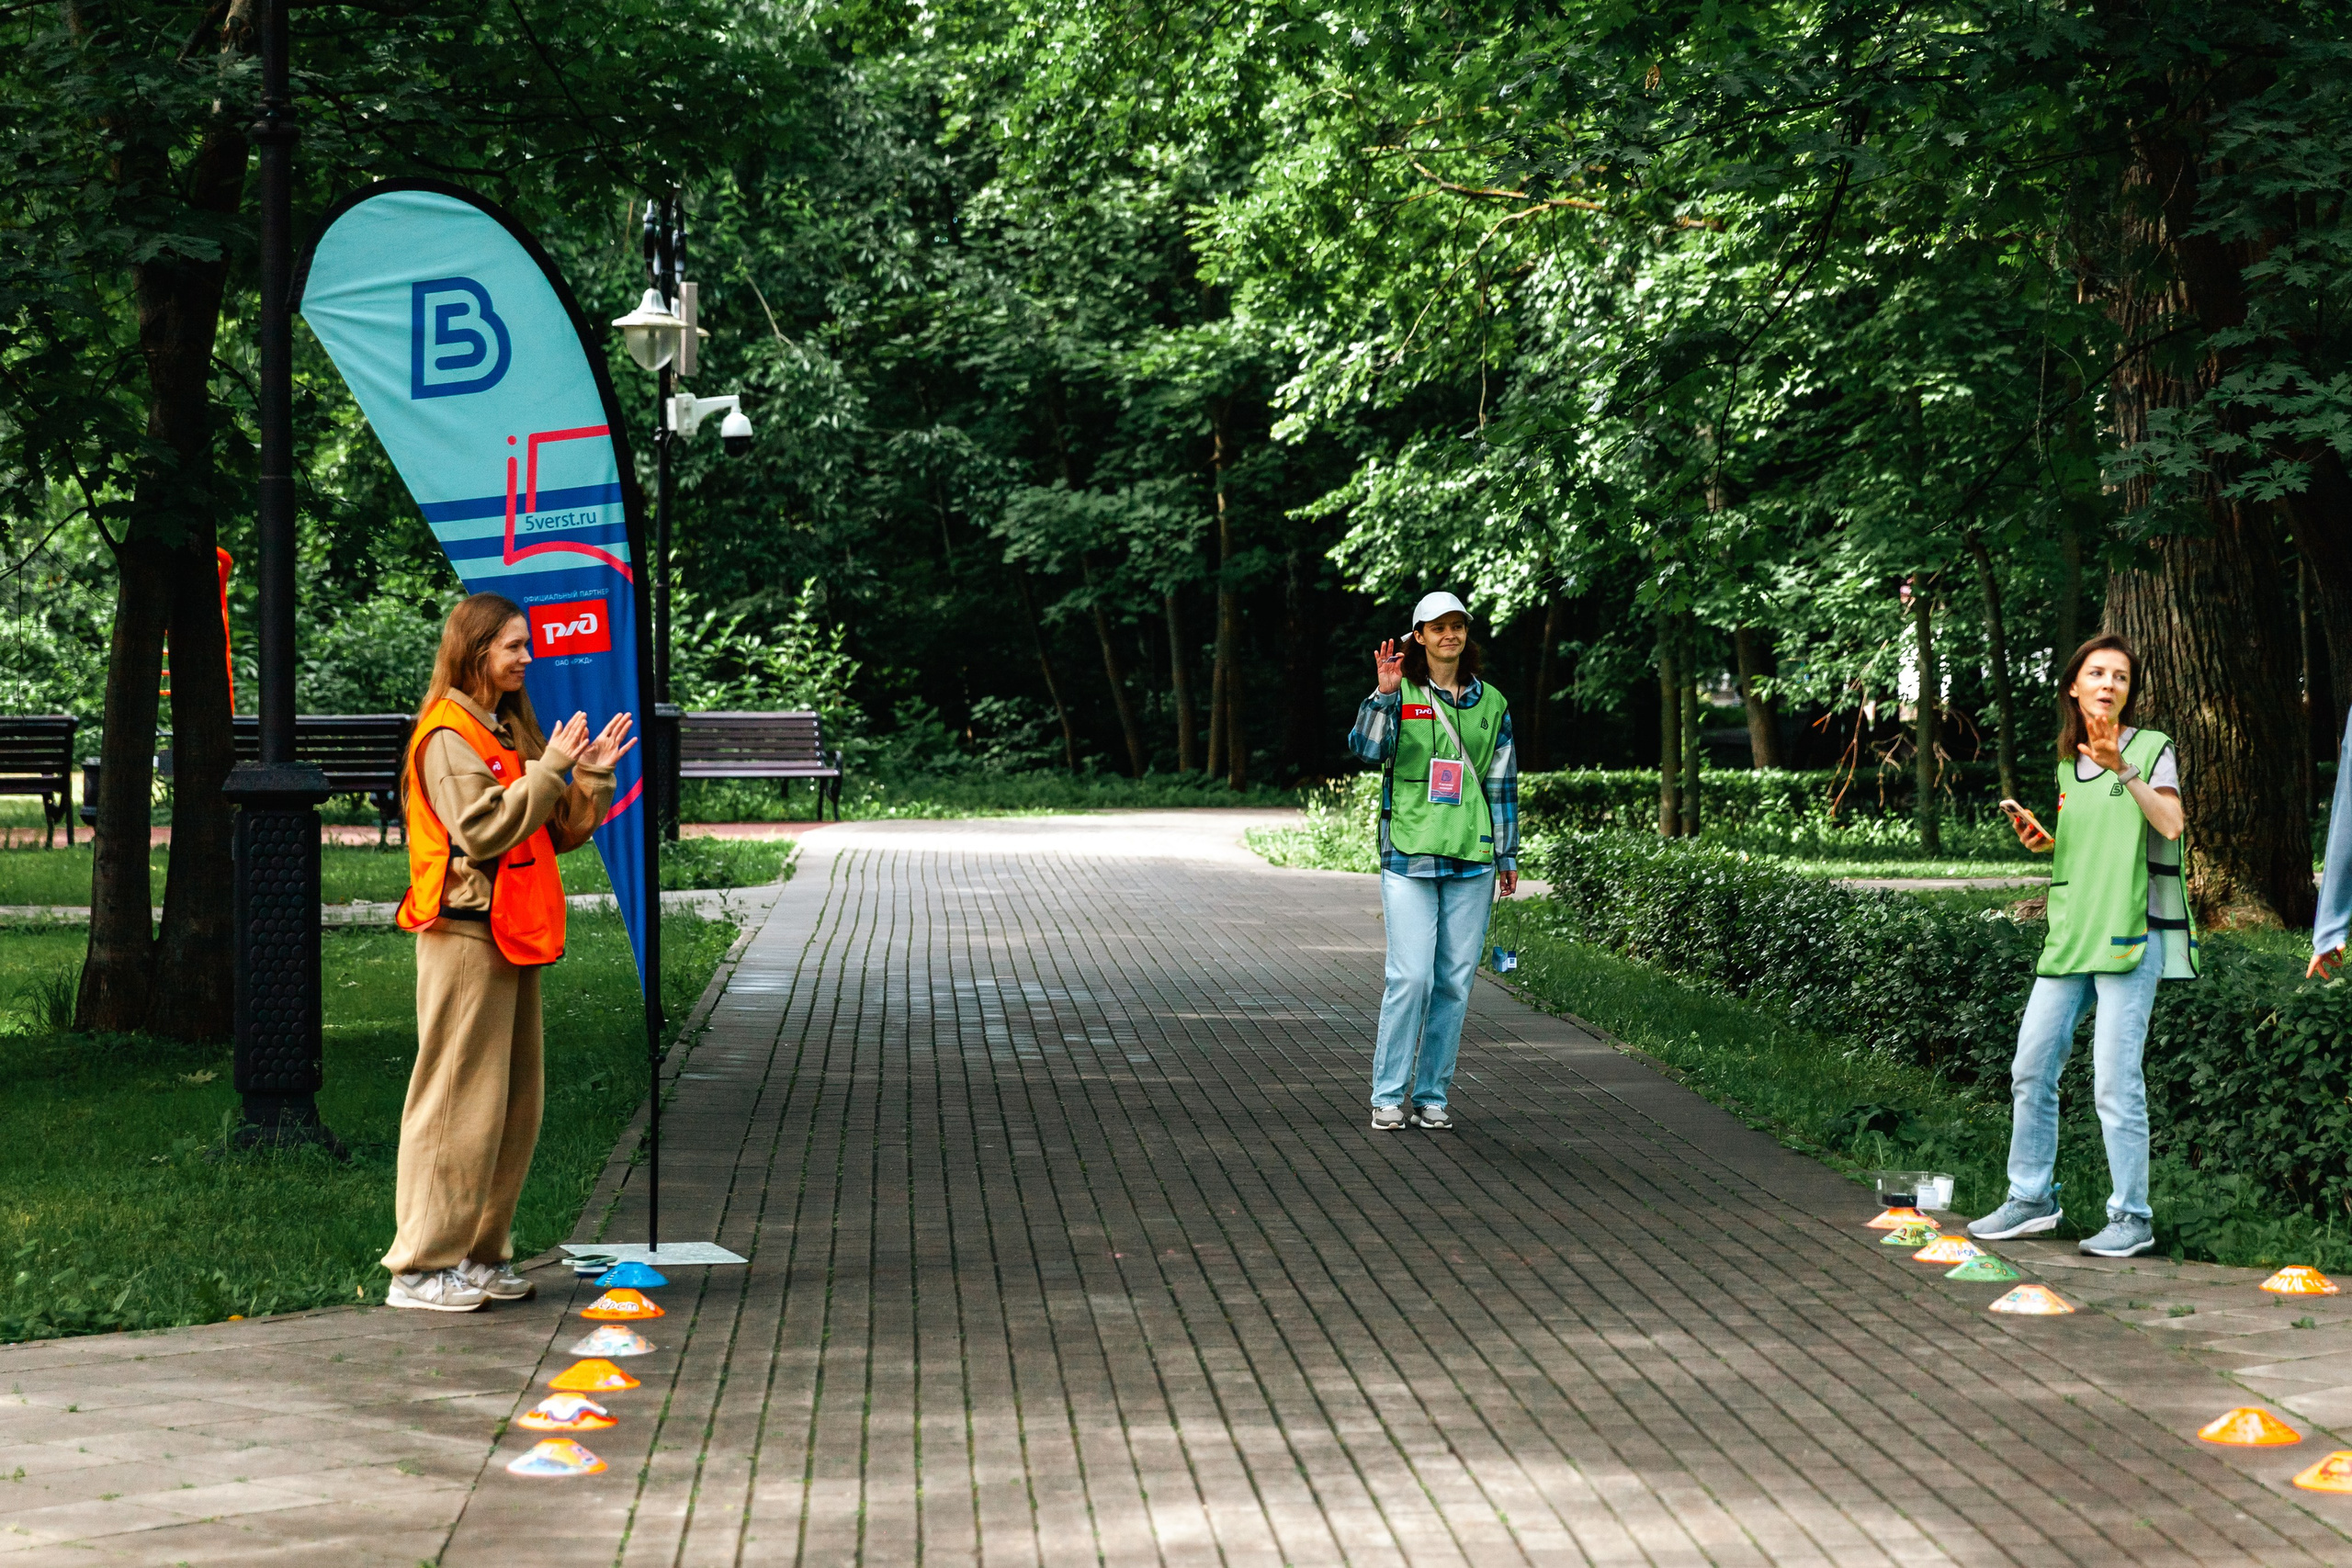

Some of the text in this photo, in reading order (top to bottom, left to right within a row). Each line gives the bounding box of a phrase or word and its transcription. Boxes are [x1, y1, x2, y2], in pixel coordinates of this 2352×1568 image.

[525, 511, 597, 531] 5verst.ru
[524, 588, 609, 603] ОФИЦИАЛЬНЫЙ ПАРТНЕР
[554, 659, 570, 667] ОАО
